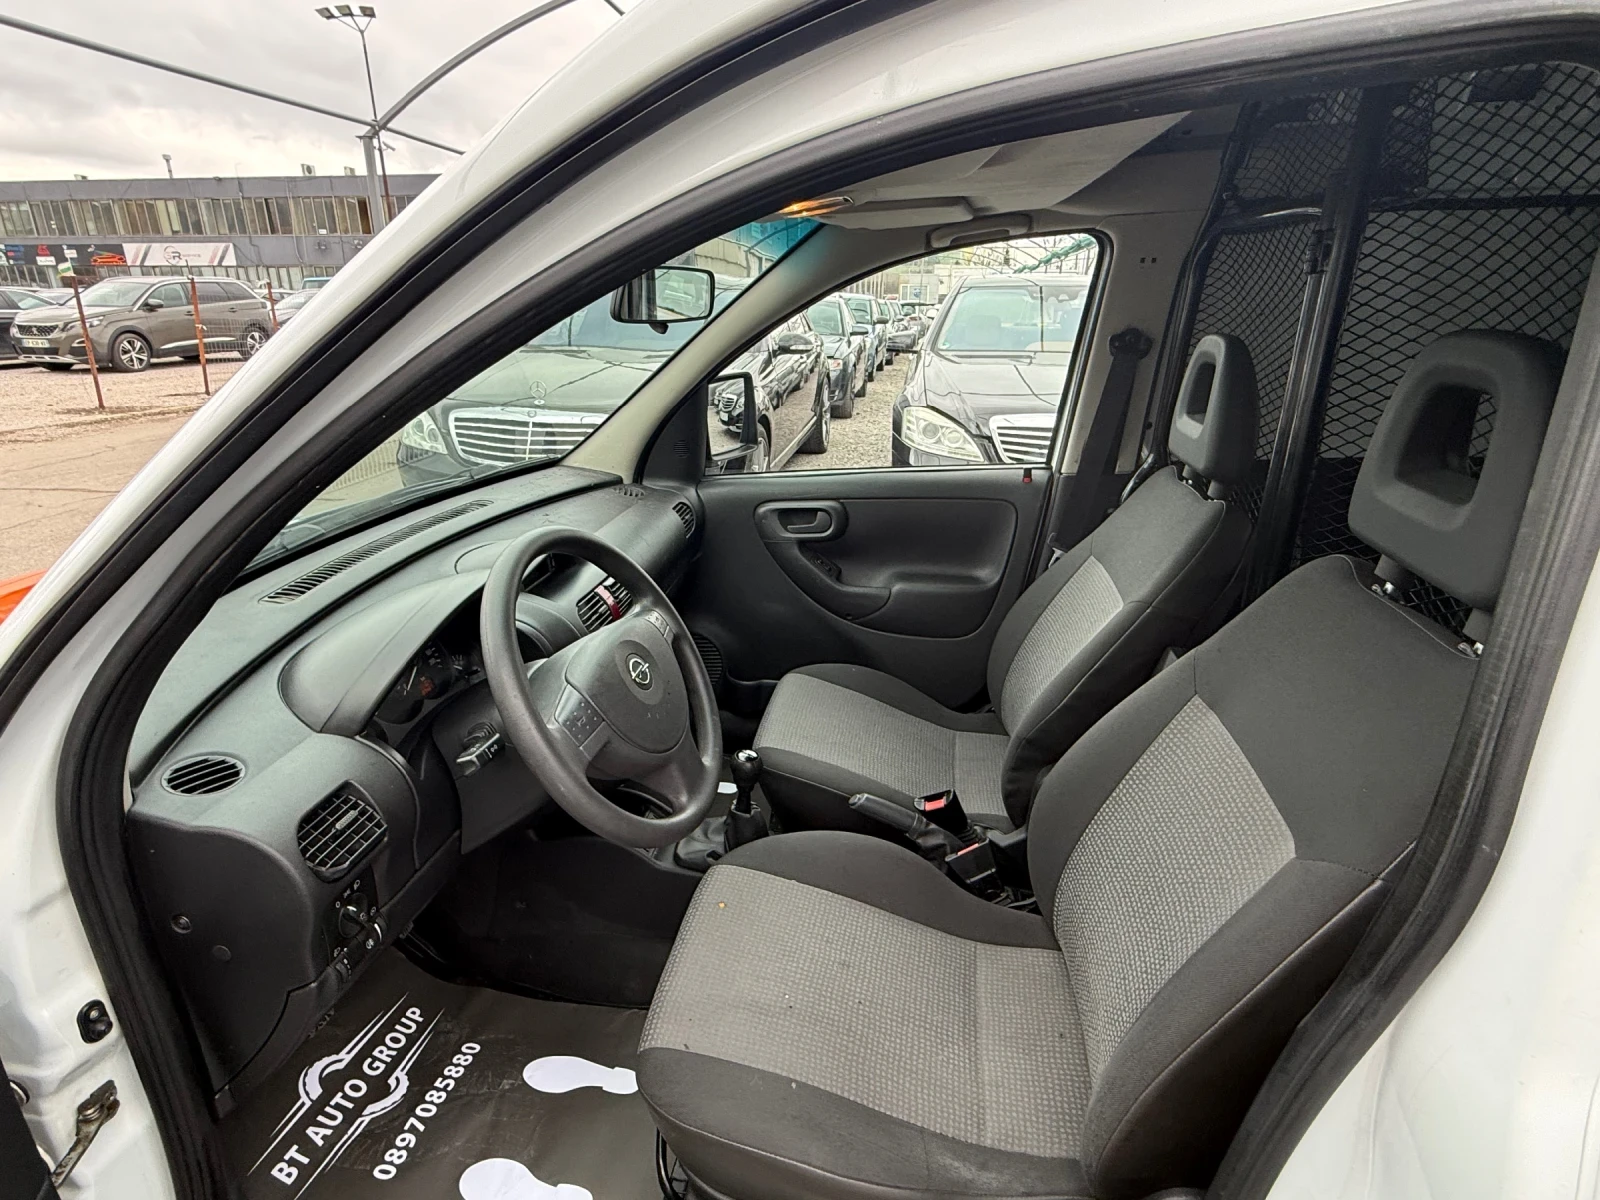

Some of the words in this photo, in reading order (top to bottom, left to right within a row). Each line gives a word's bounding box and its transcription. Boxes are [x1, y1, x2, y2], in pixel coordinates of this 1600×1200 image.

[270, 1144, 310, 1186] BT
[305, 1079, 369, 1147] AUTO
[362, 1006, 425, 1077] GROUP
[372, 1042, 482, 1181] 0897085880
